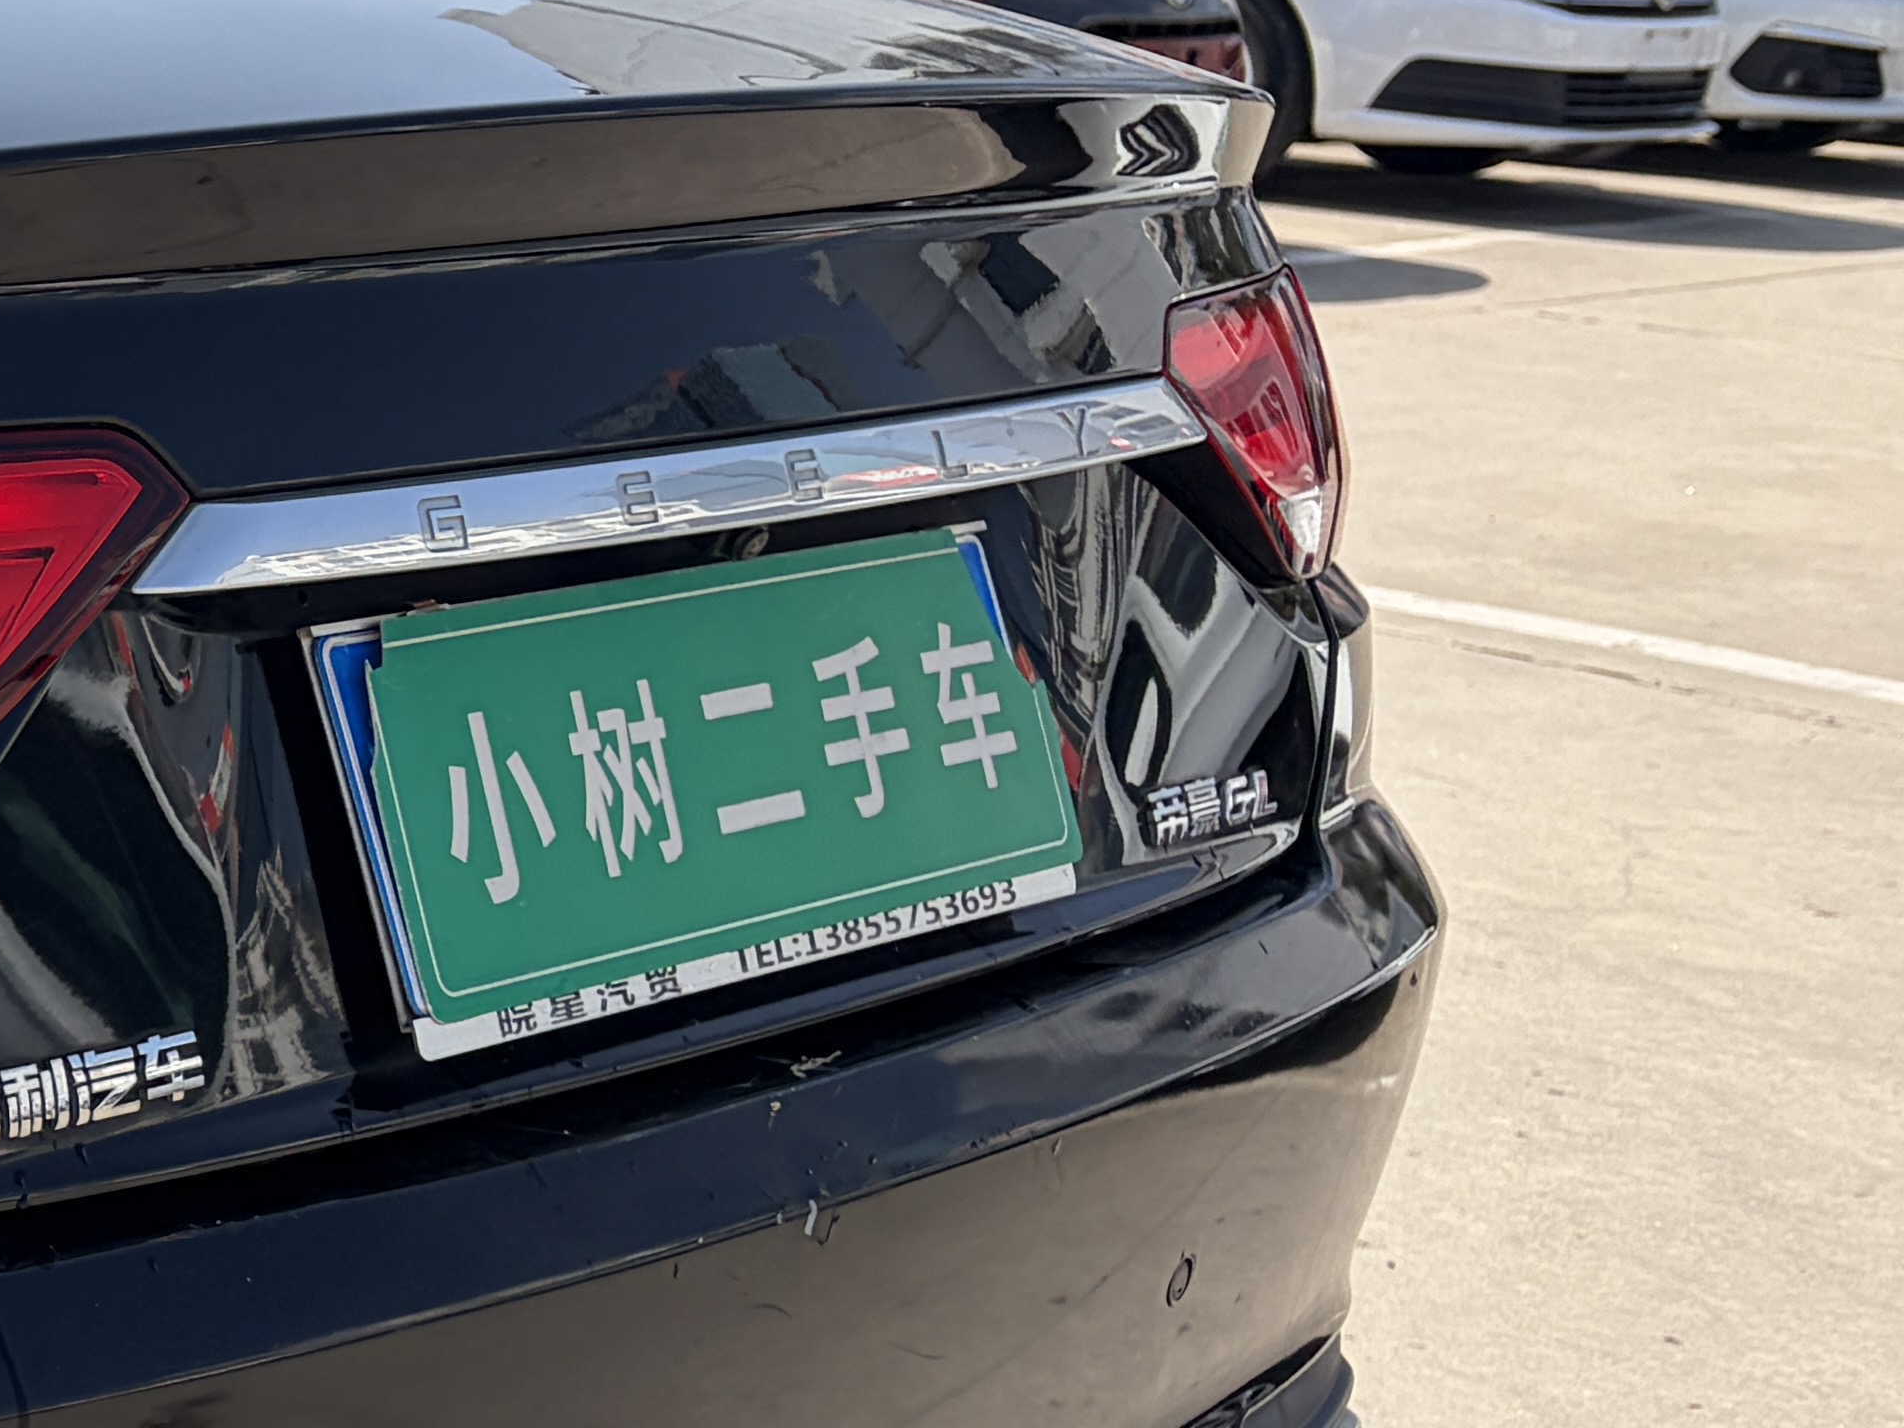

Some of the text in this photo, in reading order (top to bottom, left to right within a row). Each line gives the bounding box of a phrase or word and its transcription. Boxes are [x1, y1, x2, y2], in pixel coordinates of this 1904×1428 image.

[416, 406, 1090, 552] GEELY
[449, 621, 1018, 905] 小树二手车
